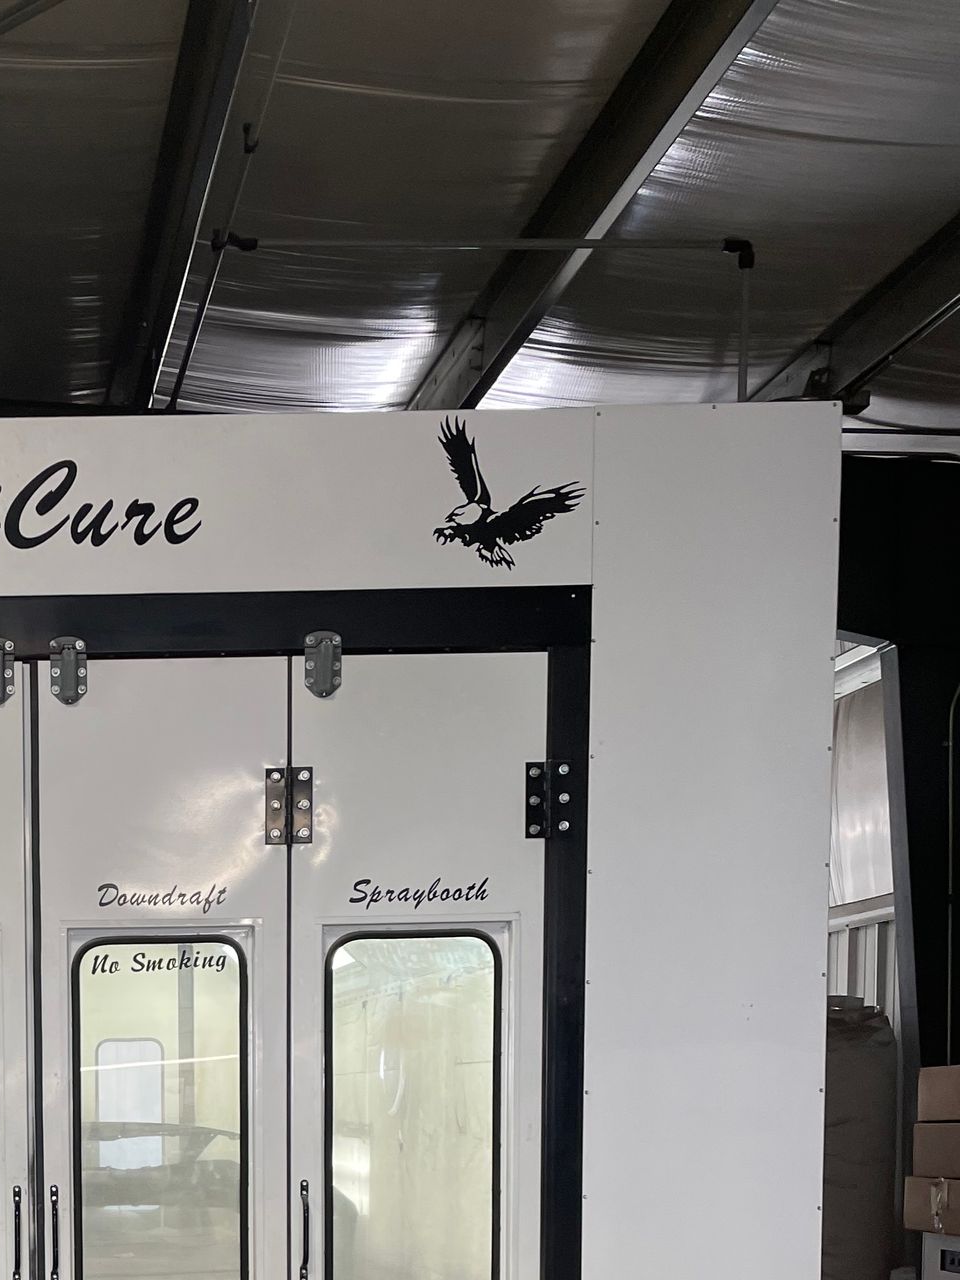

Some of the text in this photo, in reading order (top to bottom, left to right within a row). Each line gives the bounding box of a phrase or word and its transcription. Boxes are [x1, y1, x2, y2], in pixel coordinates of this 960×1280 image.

[97, 883, 227, 914] Downdraft
[349, 878, 489, 910] Spraybooth
[91, 951, 227, 975] No Smoking
